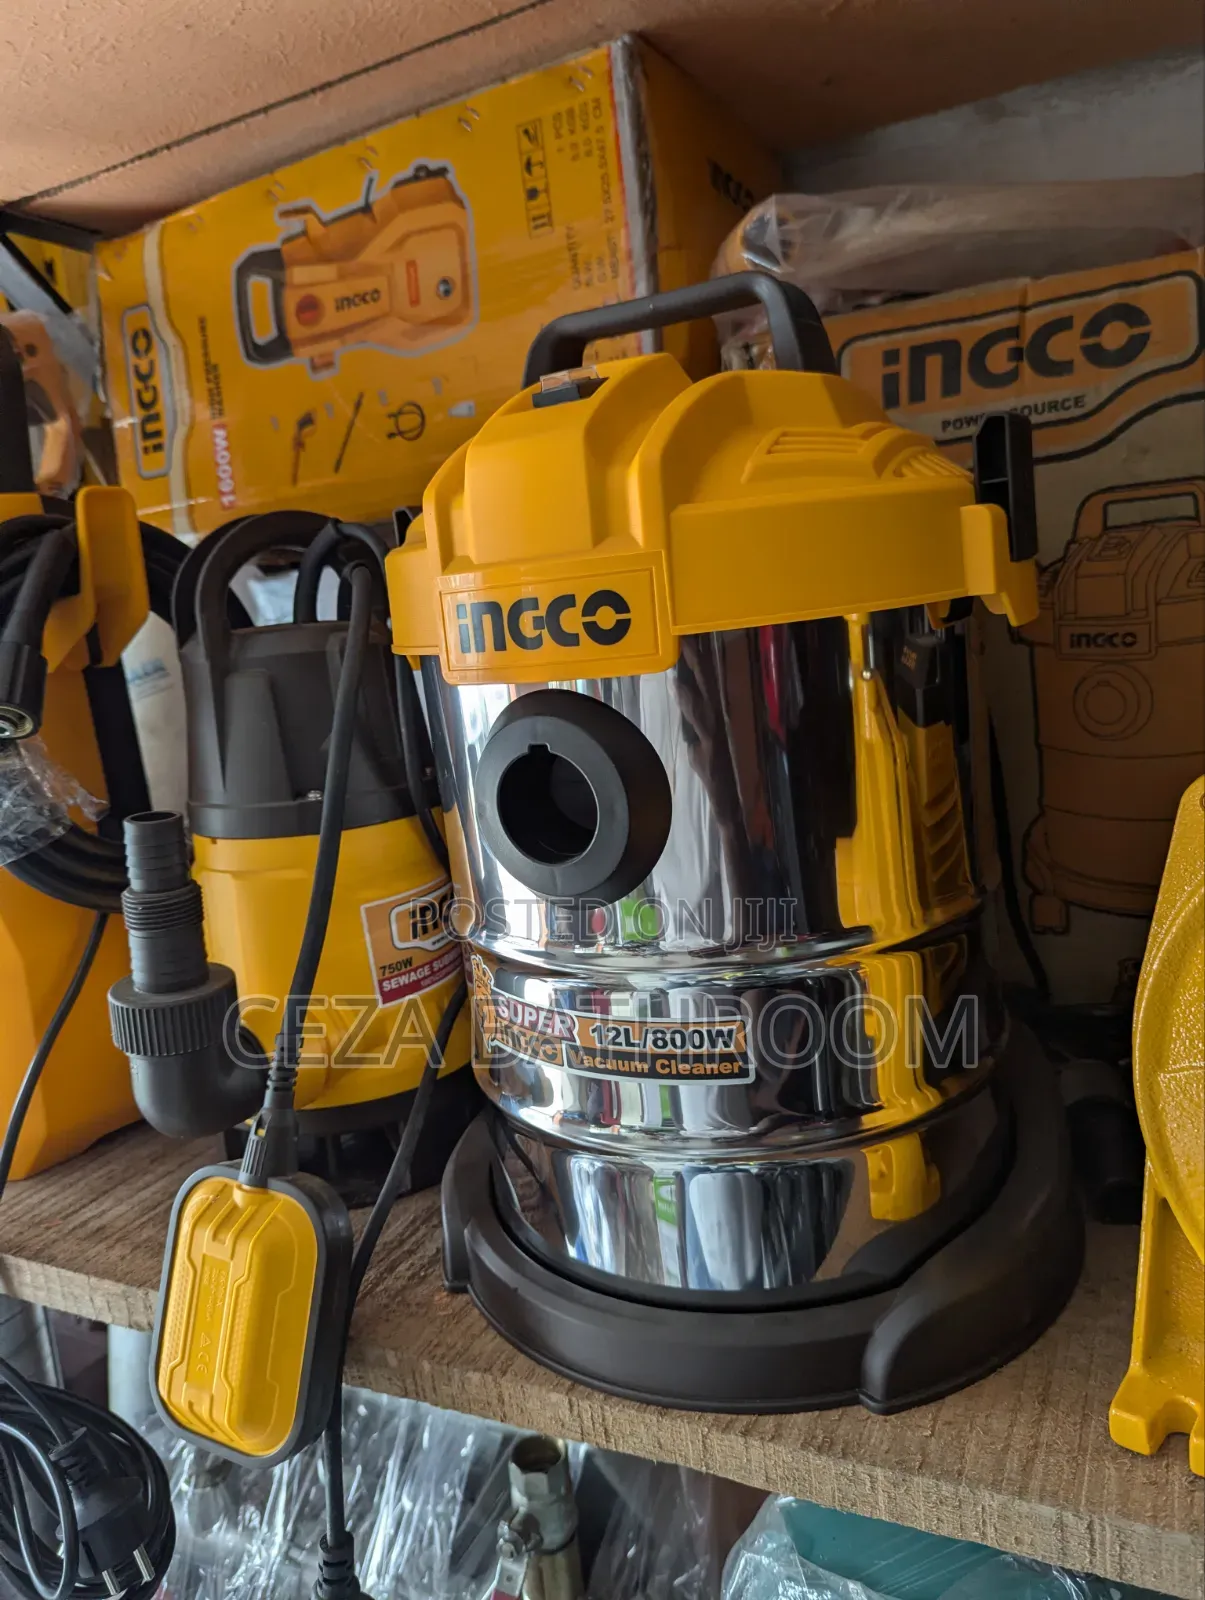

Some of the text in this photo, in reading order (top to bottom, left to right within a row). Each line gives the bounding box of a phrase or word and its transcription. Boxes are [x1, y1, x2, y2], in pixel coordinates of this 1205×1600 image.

[380, 956, 413, 977] 750W
[383, 965, 431, 992] SEWAGE
[497, 995, 572, 1038] SUPER
[590, 1023, 734, 1050] 12L/800W
[570, 1047, 742, 1076] Vacuum Cleaner
